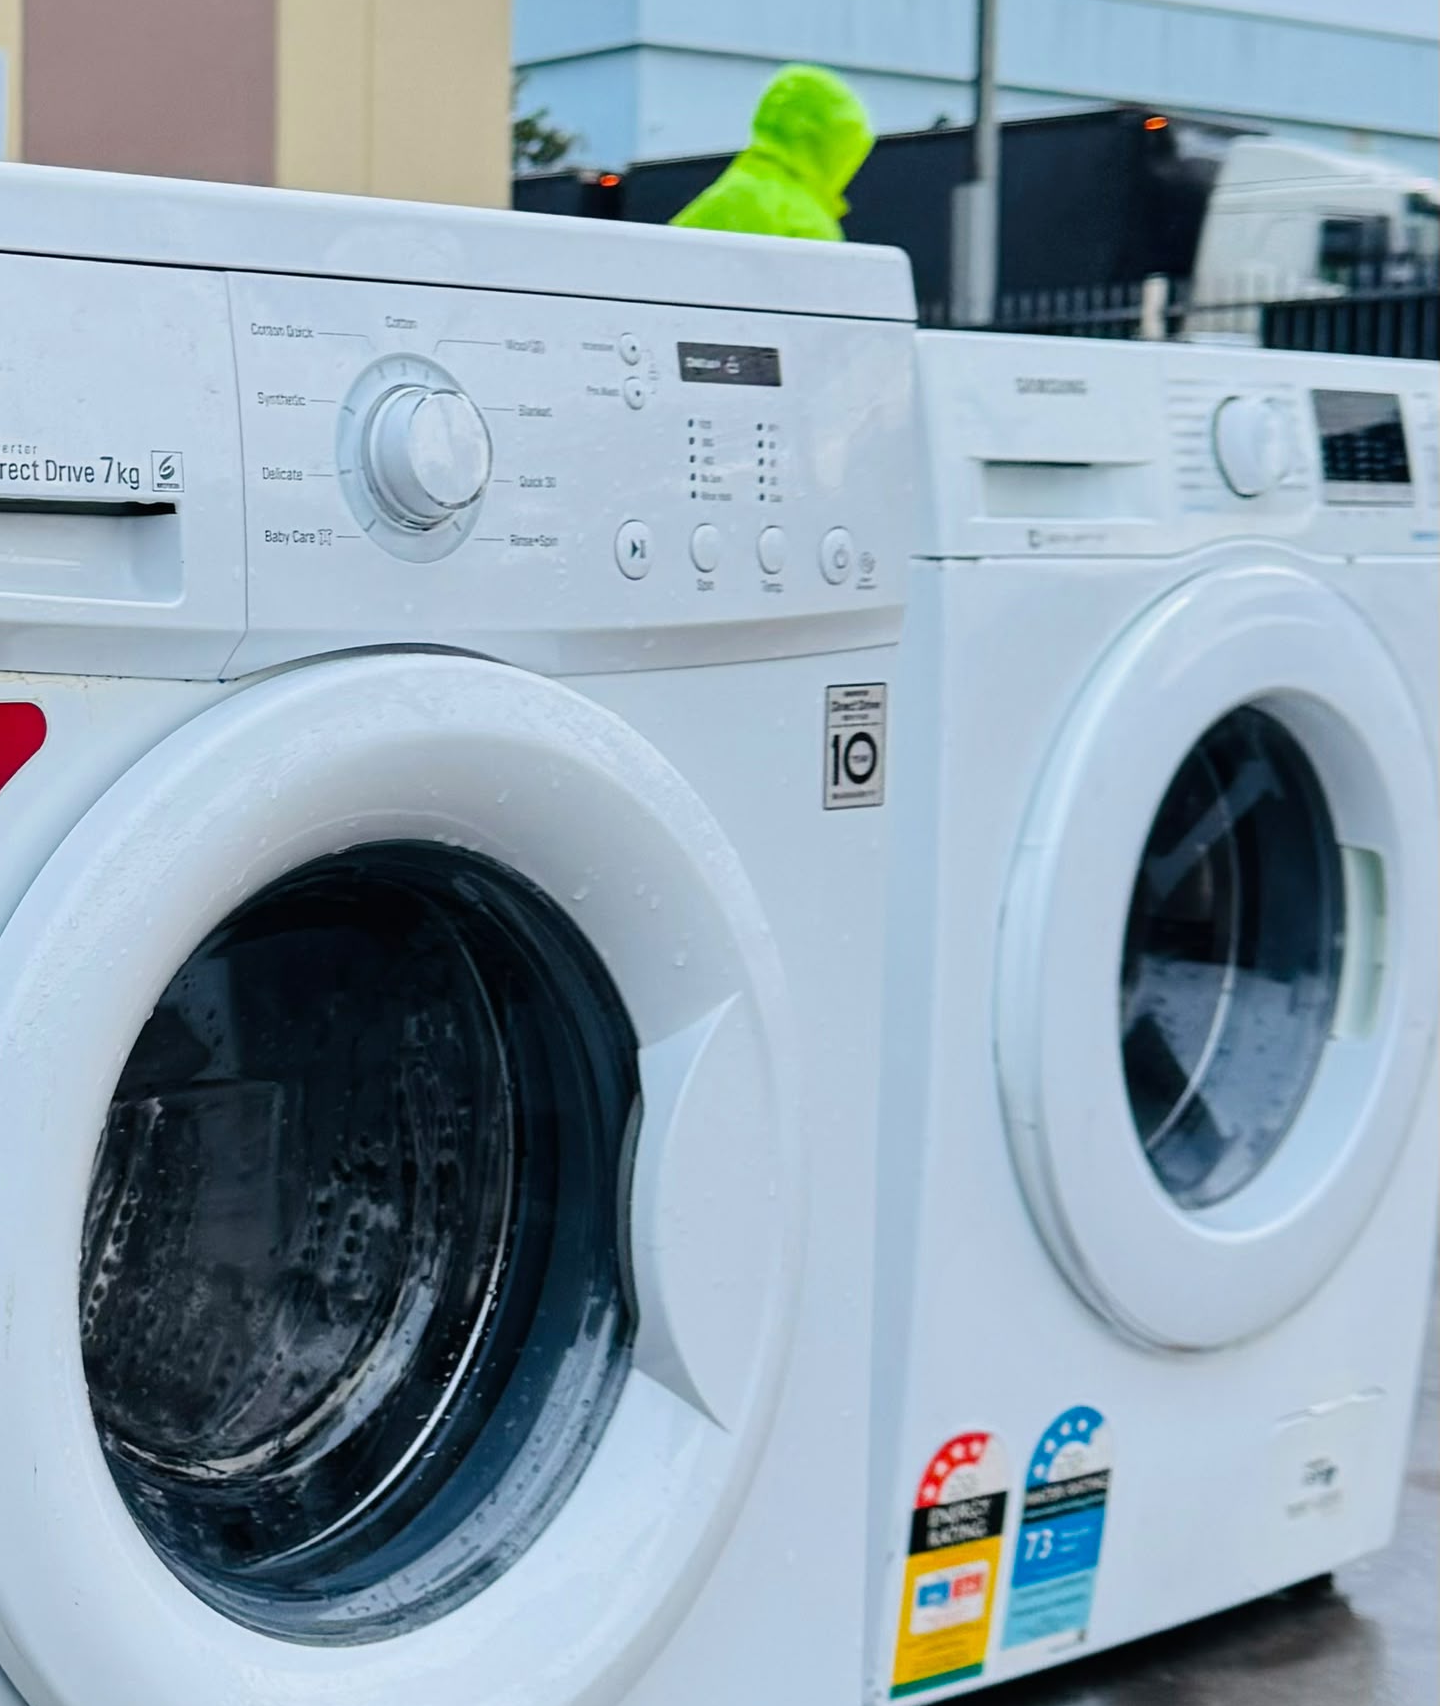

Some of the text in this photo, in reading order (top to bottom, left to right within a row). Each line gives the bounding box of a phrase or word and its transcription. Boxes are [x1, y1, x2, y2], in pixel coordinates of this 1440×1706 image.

[46, 460, 95, 484] Drive
[262, 467, 303, 481] Delicate
[264, 530, 316, 545] Baby Care
[832, 732, 877, 786] 10
[1025, 1529, 1054, 1561] 73
